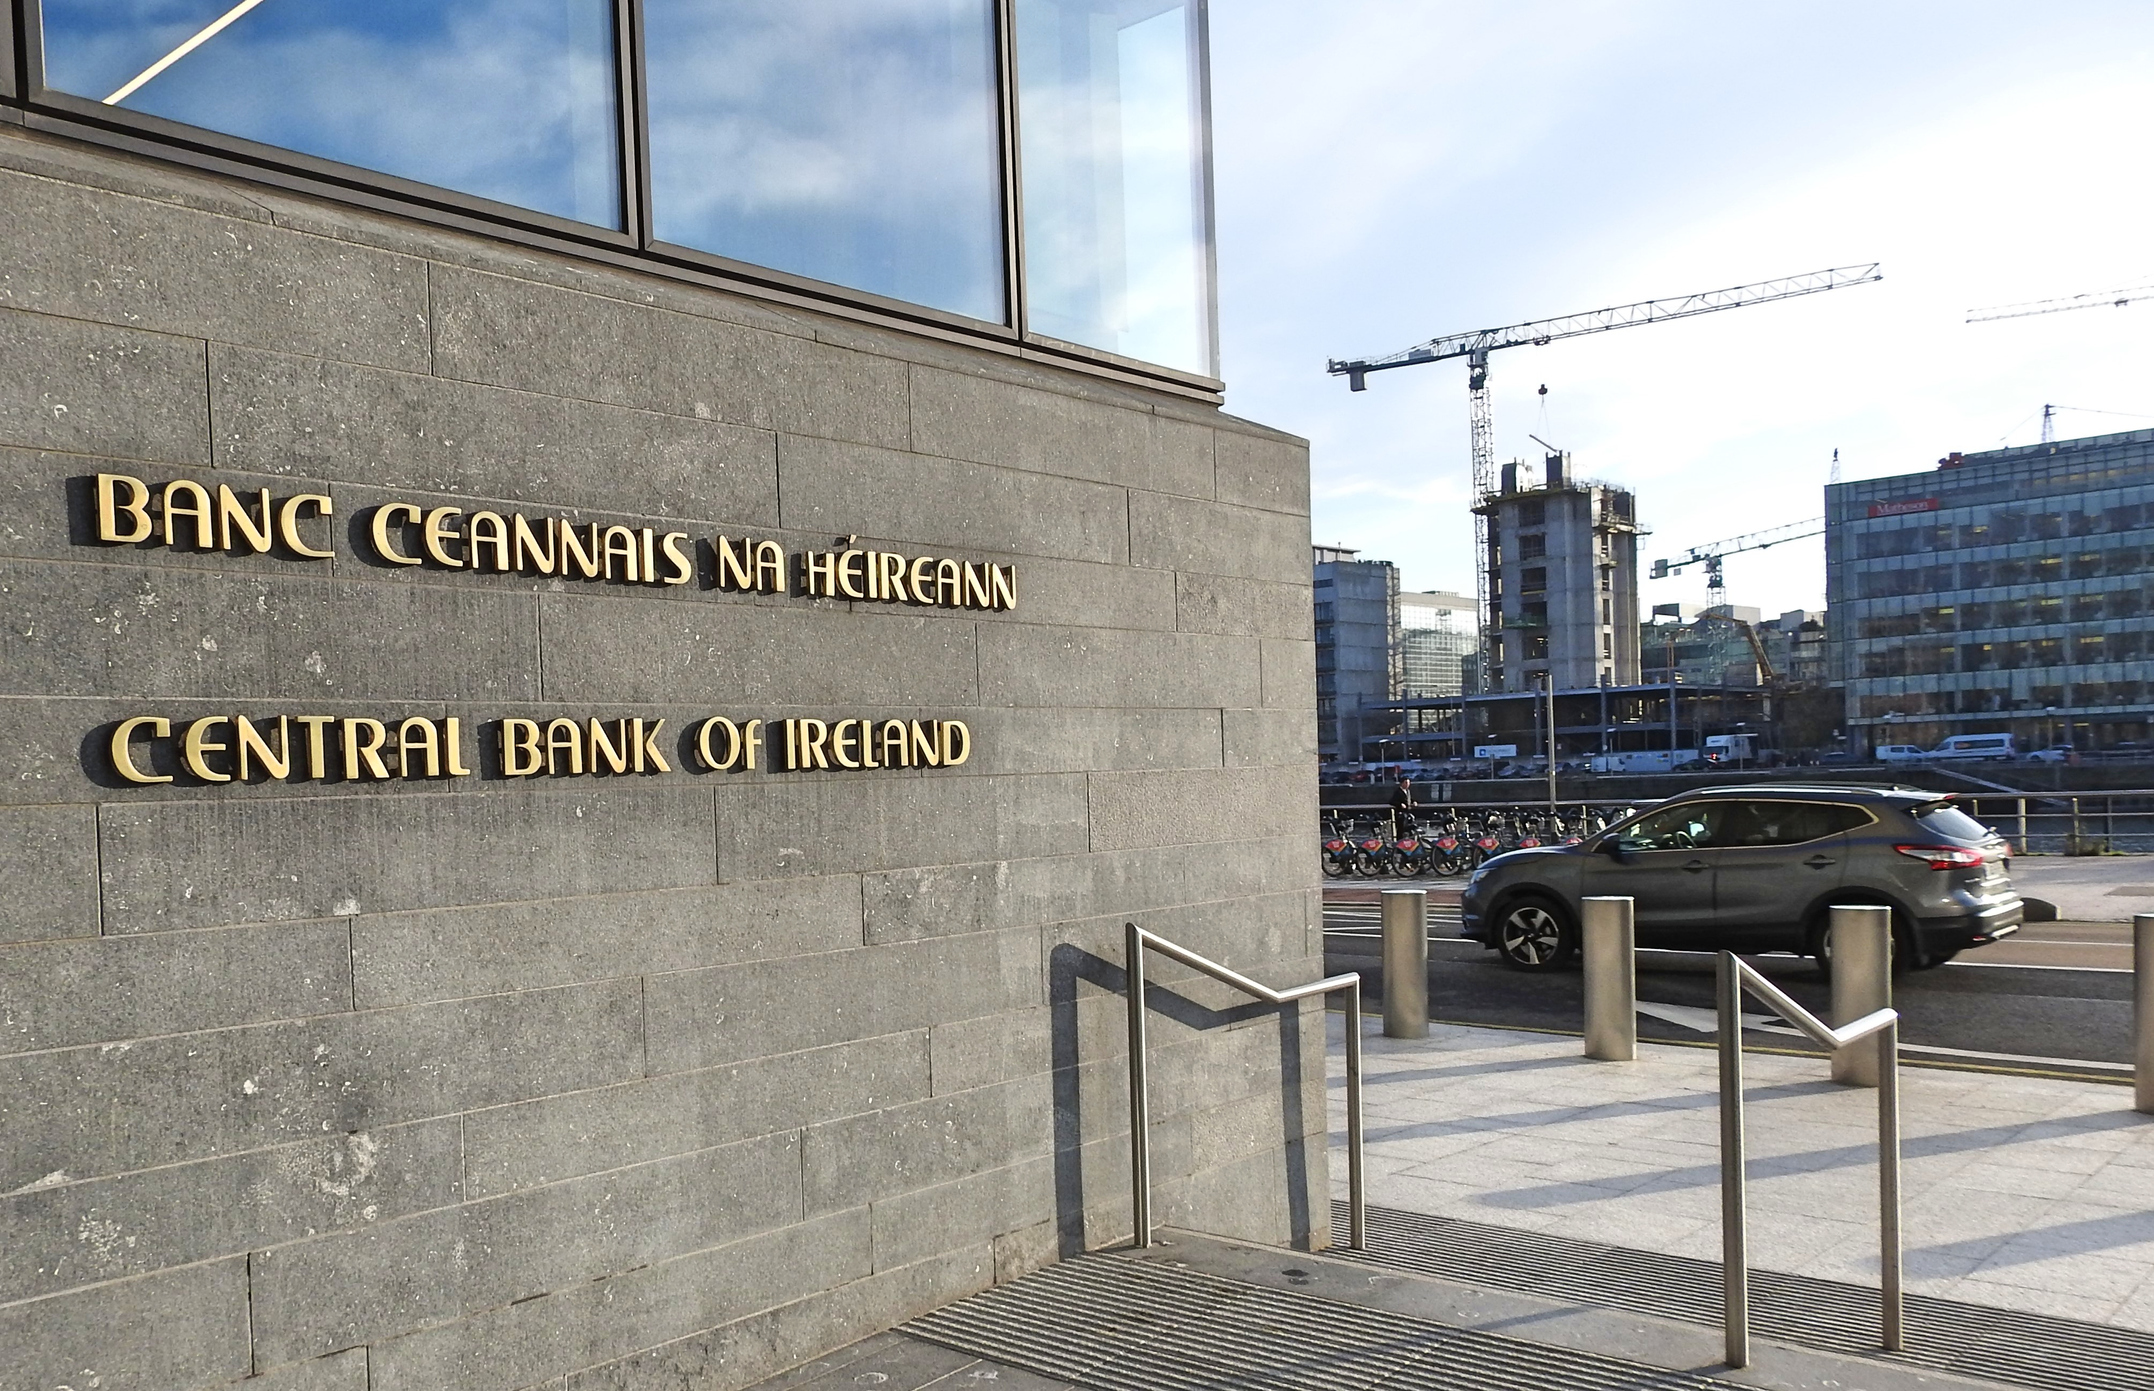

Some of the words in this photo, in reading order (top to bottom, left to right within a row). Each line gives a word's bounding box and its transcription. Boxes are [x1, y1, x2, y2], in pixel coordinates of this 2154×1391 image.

[96, 473, 335, 558] BANC
[370, 502, 693, 586] CEANNAIS
[717, 534, 786, 593] NA
[805, 534, 1018, 610] HÉIREANN
[110, 715, 471, 783] CENTRAL
[501, 716, 672, 777] BANK
[785, 717, 971, 769] IRELAND
